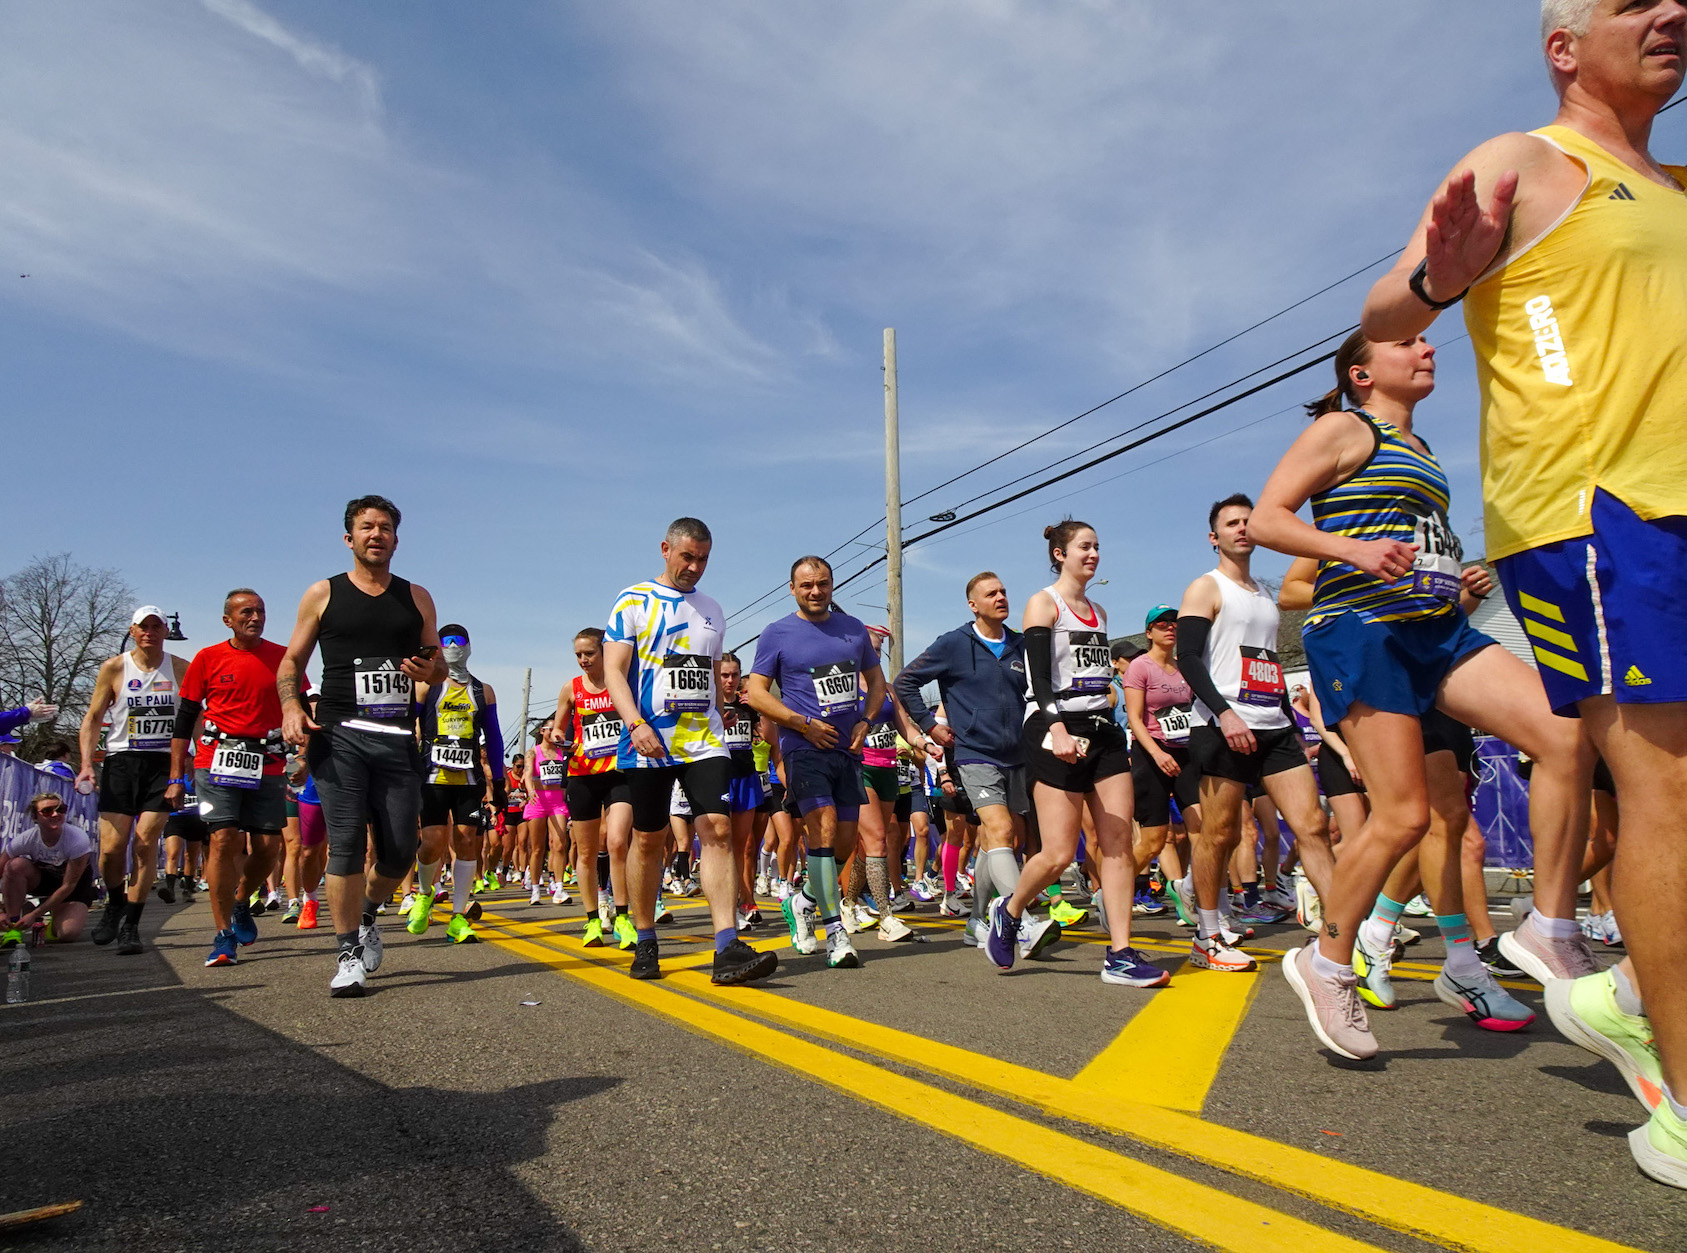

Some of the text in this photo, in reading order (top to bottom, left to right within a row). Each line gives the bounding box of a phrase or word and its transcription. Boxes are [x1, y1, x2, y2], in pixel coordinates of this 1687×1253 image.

[1525, 295, 1573, 387] ADIZERO
[1075, 647, 1112, 668] 15403
[668, 669, 710, 690] 16635
[1248, 660, 1280, 684] 4803
[362, 673, 410, 694] 15143
[819, 674, 854, 696] 16607
[127, 695, 175, 707] DE PAUL
[135, 719, 174, 734] 16779
[584, 722, 621, 741] 14126
[1163, 714, 1191, 732] 1581
[218, 751, 260, 771] 16909
[436, 749, 470, 765] 14442
